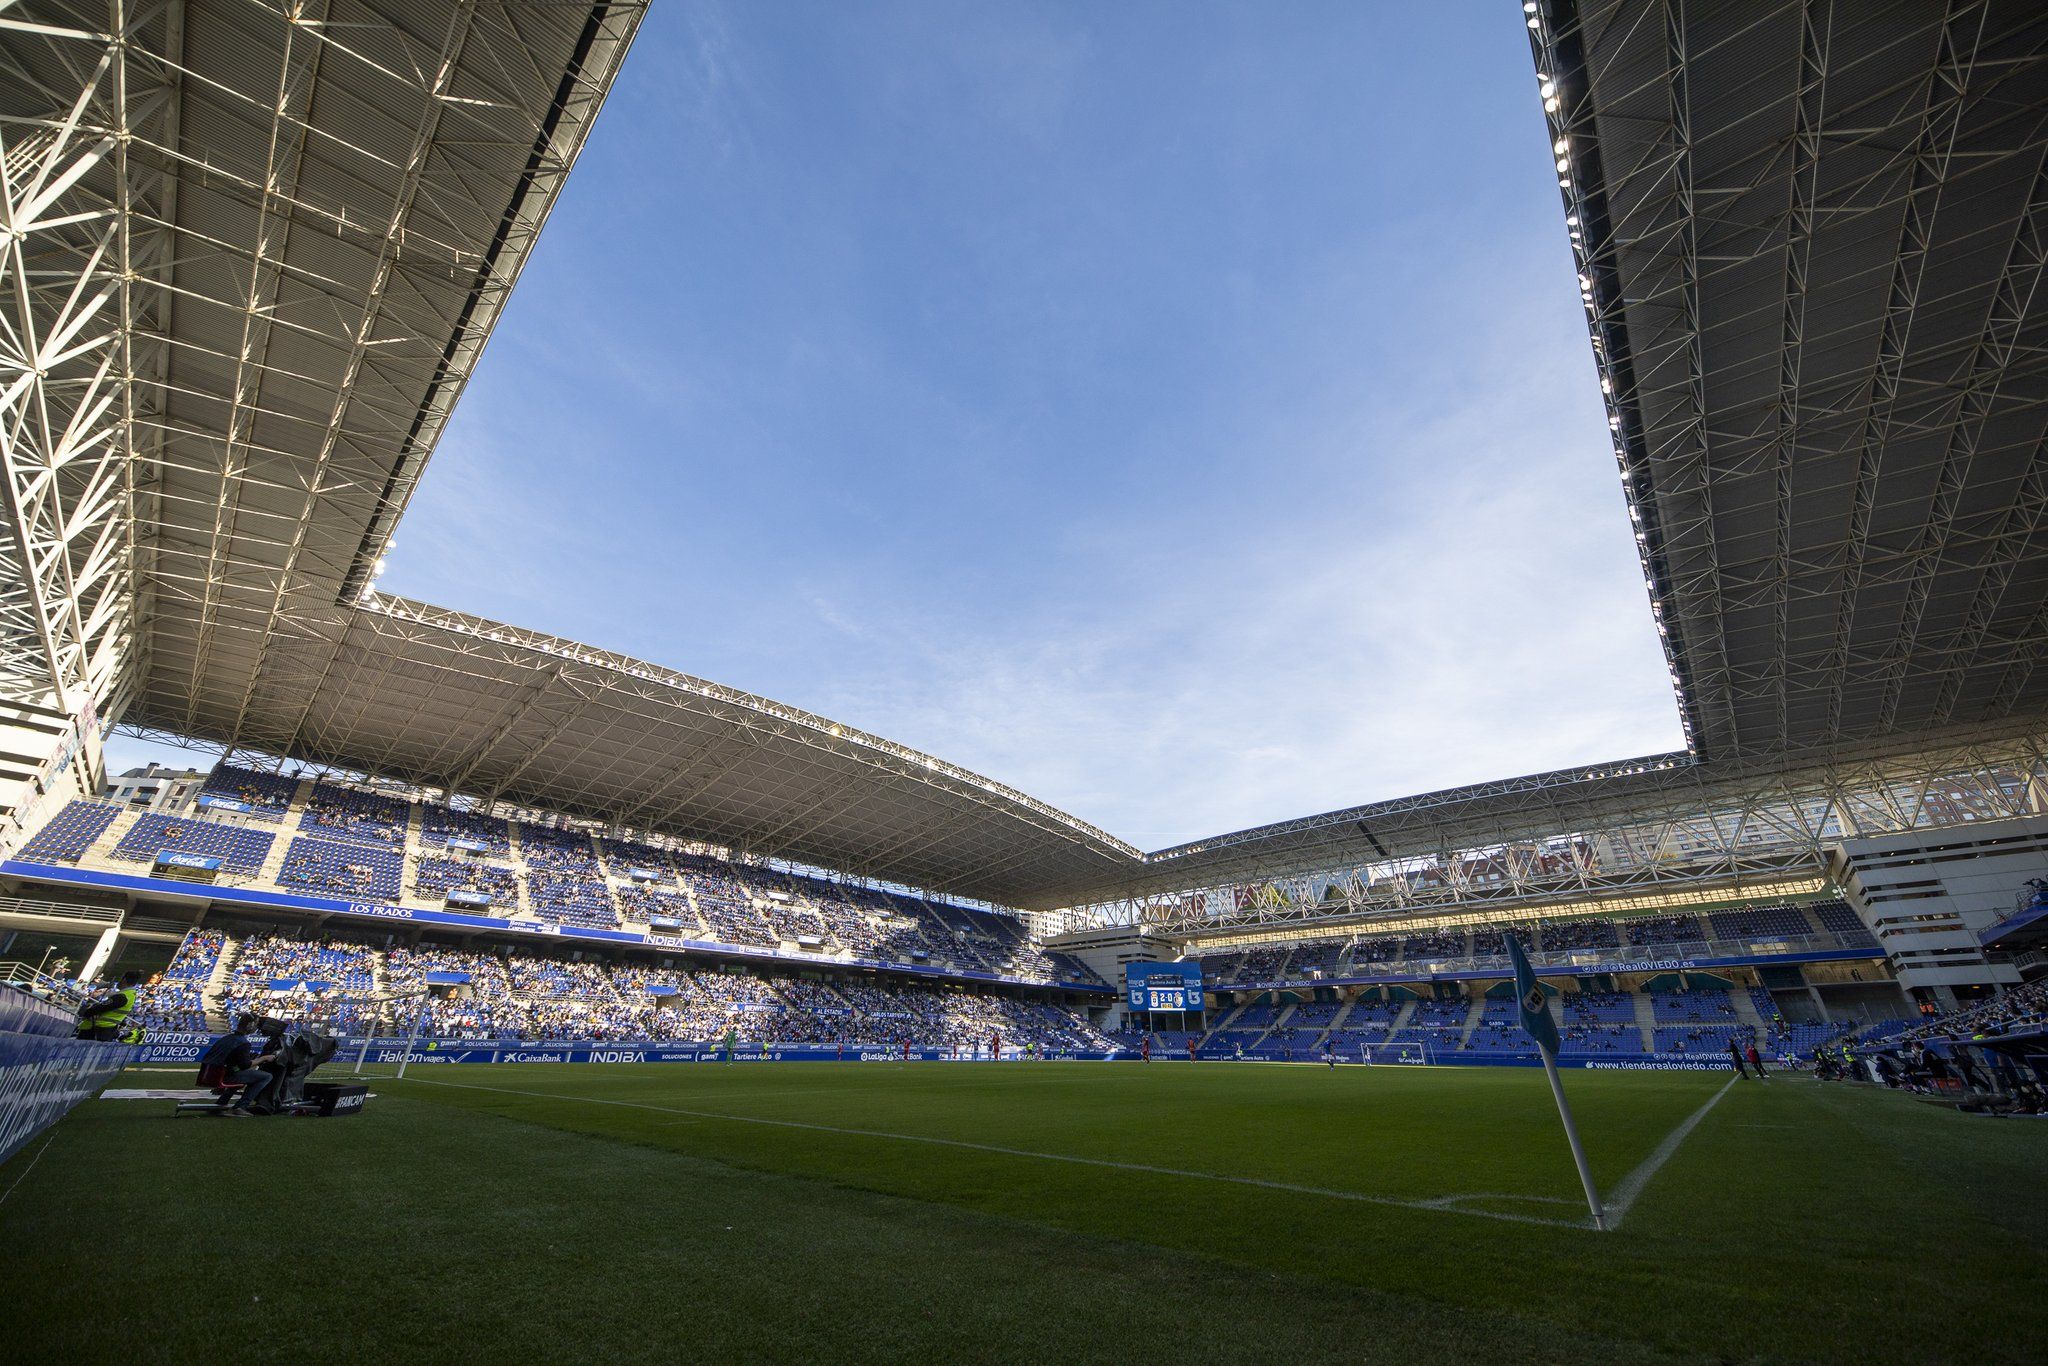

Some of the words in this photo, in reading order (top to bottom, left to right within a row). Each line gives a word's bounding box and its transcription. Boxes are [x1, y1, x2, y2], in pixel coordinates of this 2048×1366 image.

[349, 903, 371, 913] LOS
[372, 907, 414, 918] PRADOS
[643, 934, 684, 947] INDIBA
[1619, 960, 1695, 971] RealOVIEDO.es
[152, 1046, 200, 1057] OVIEDO
[588, 1051, 645, 1063] INDIBA
[423, 1055, 446, 1064] viajes
[518, 1053, 561, 1063] CaixaBank
[1595, 1061, 1732, 1071] www.tiendarealoviedo.com
